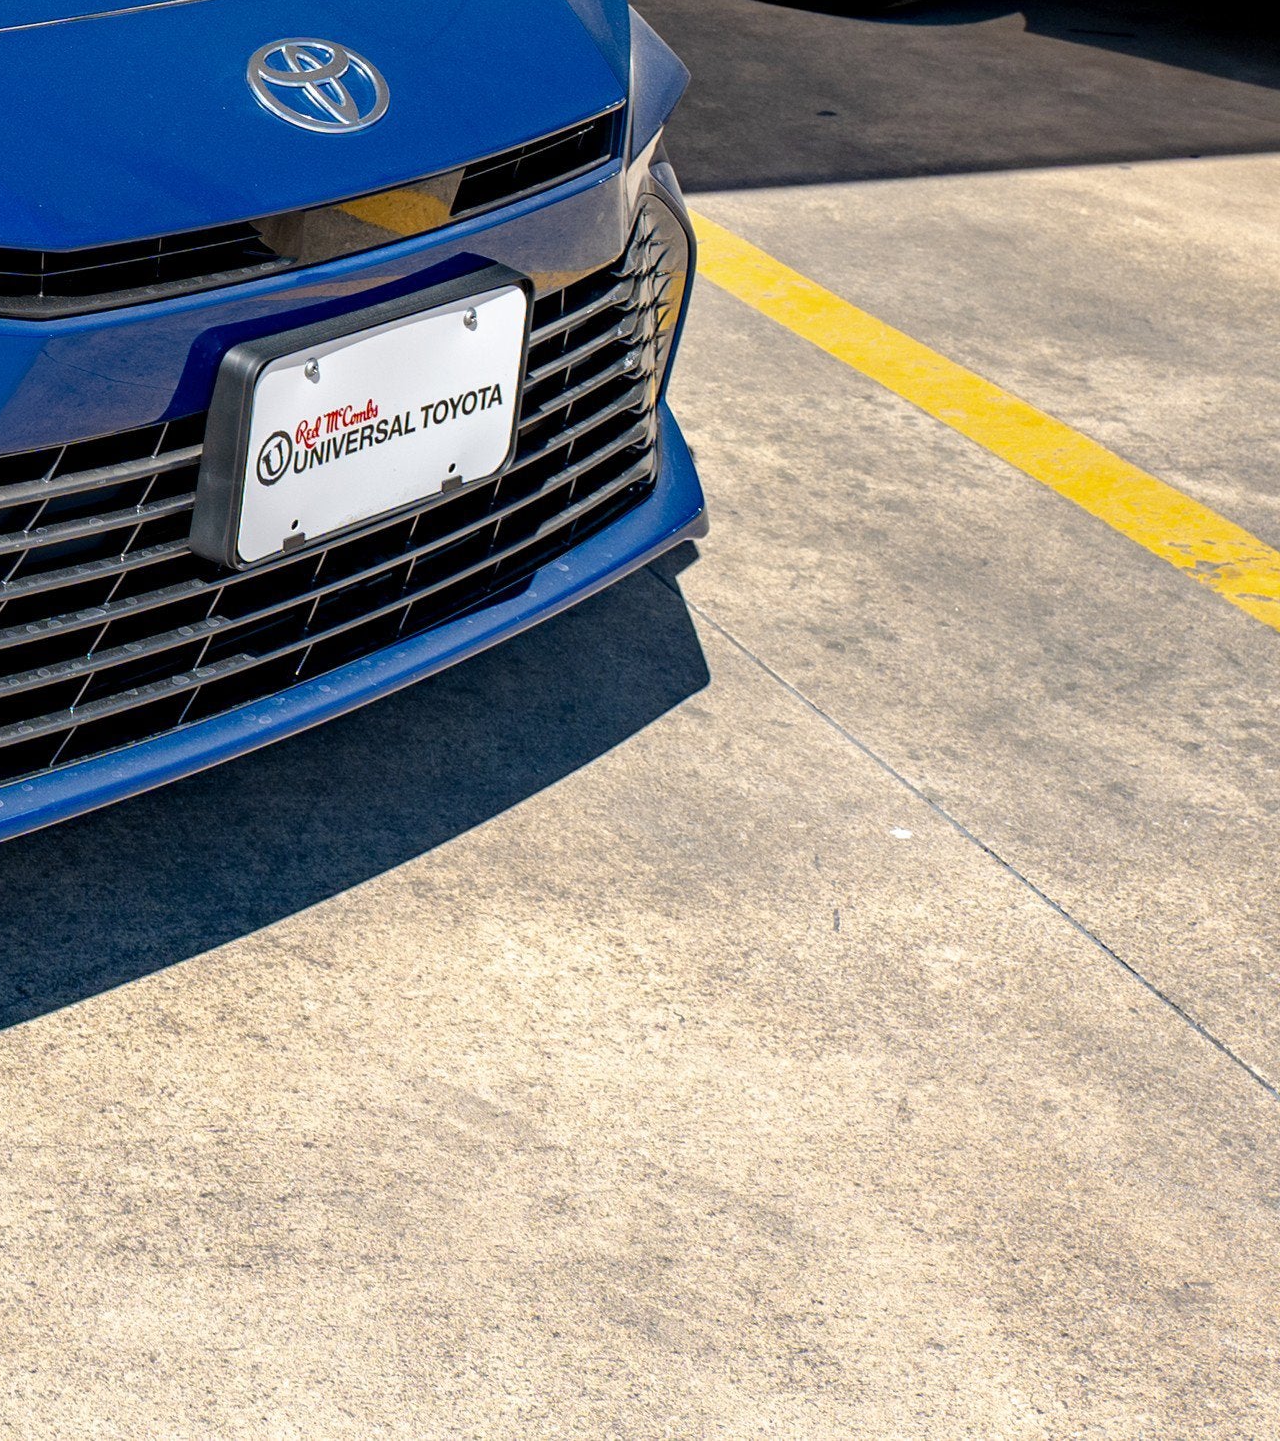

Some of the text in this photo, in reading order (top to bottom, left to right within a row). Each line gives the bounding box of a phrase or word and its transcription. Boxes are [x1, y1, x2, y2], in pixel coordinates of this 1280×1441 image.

[293, 383, 503, 474] UNIVERSAL TOYOTA
[295, 399, 379, 449] Red McCombs
